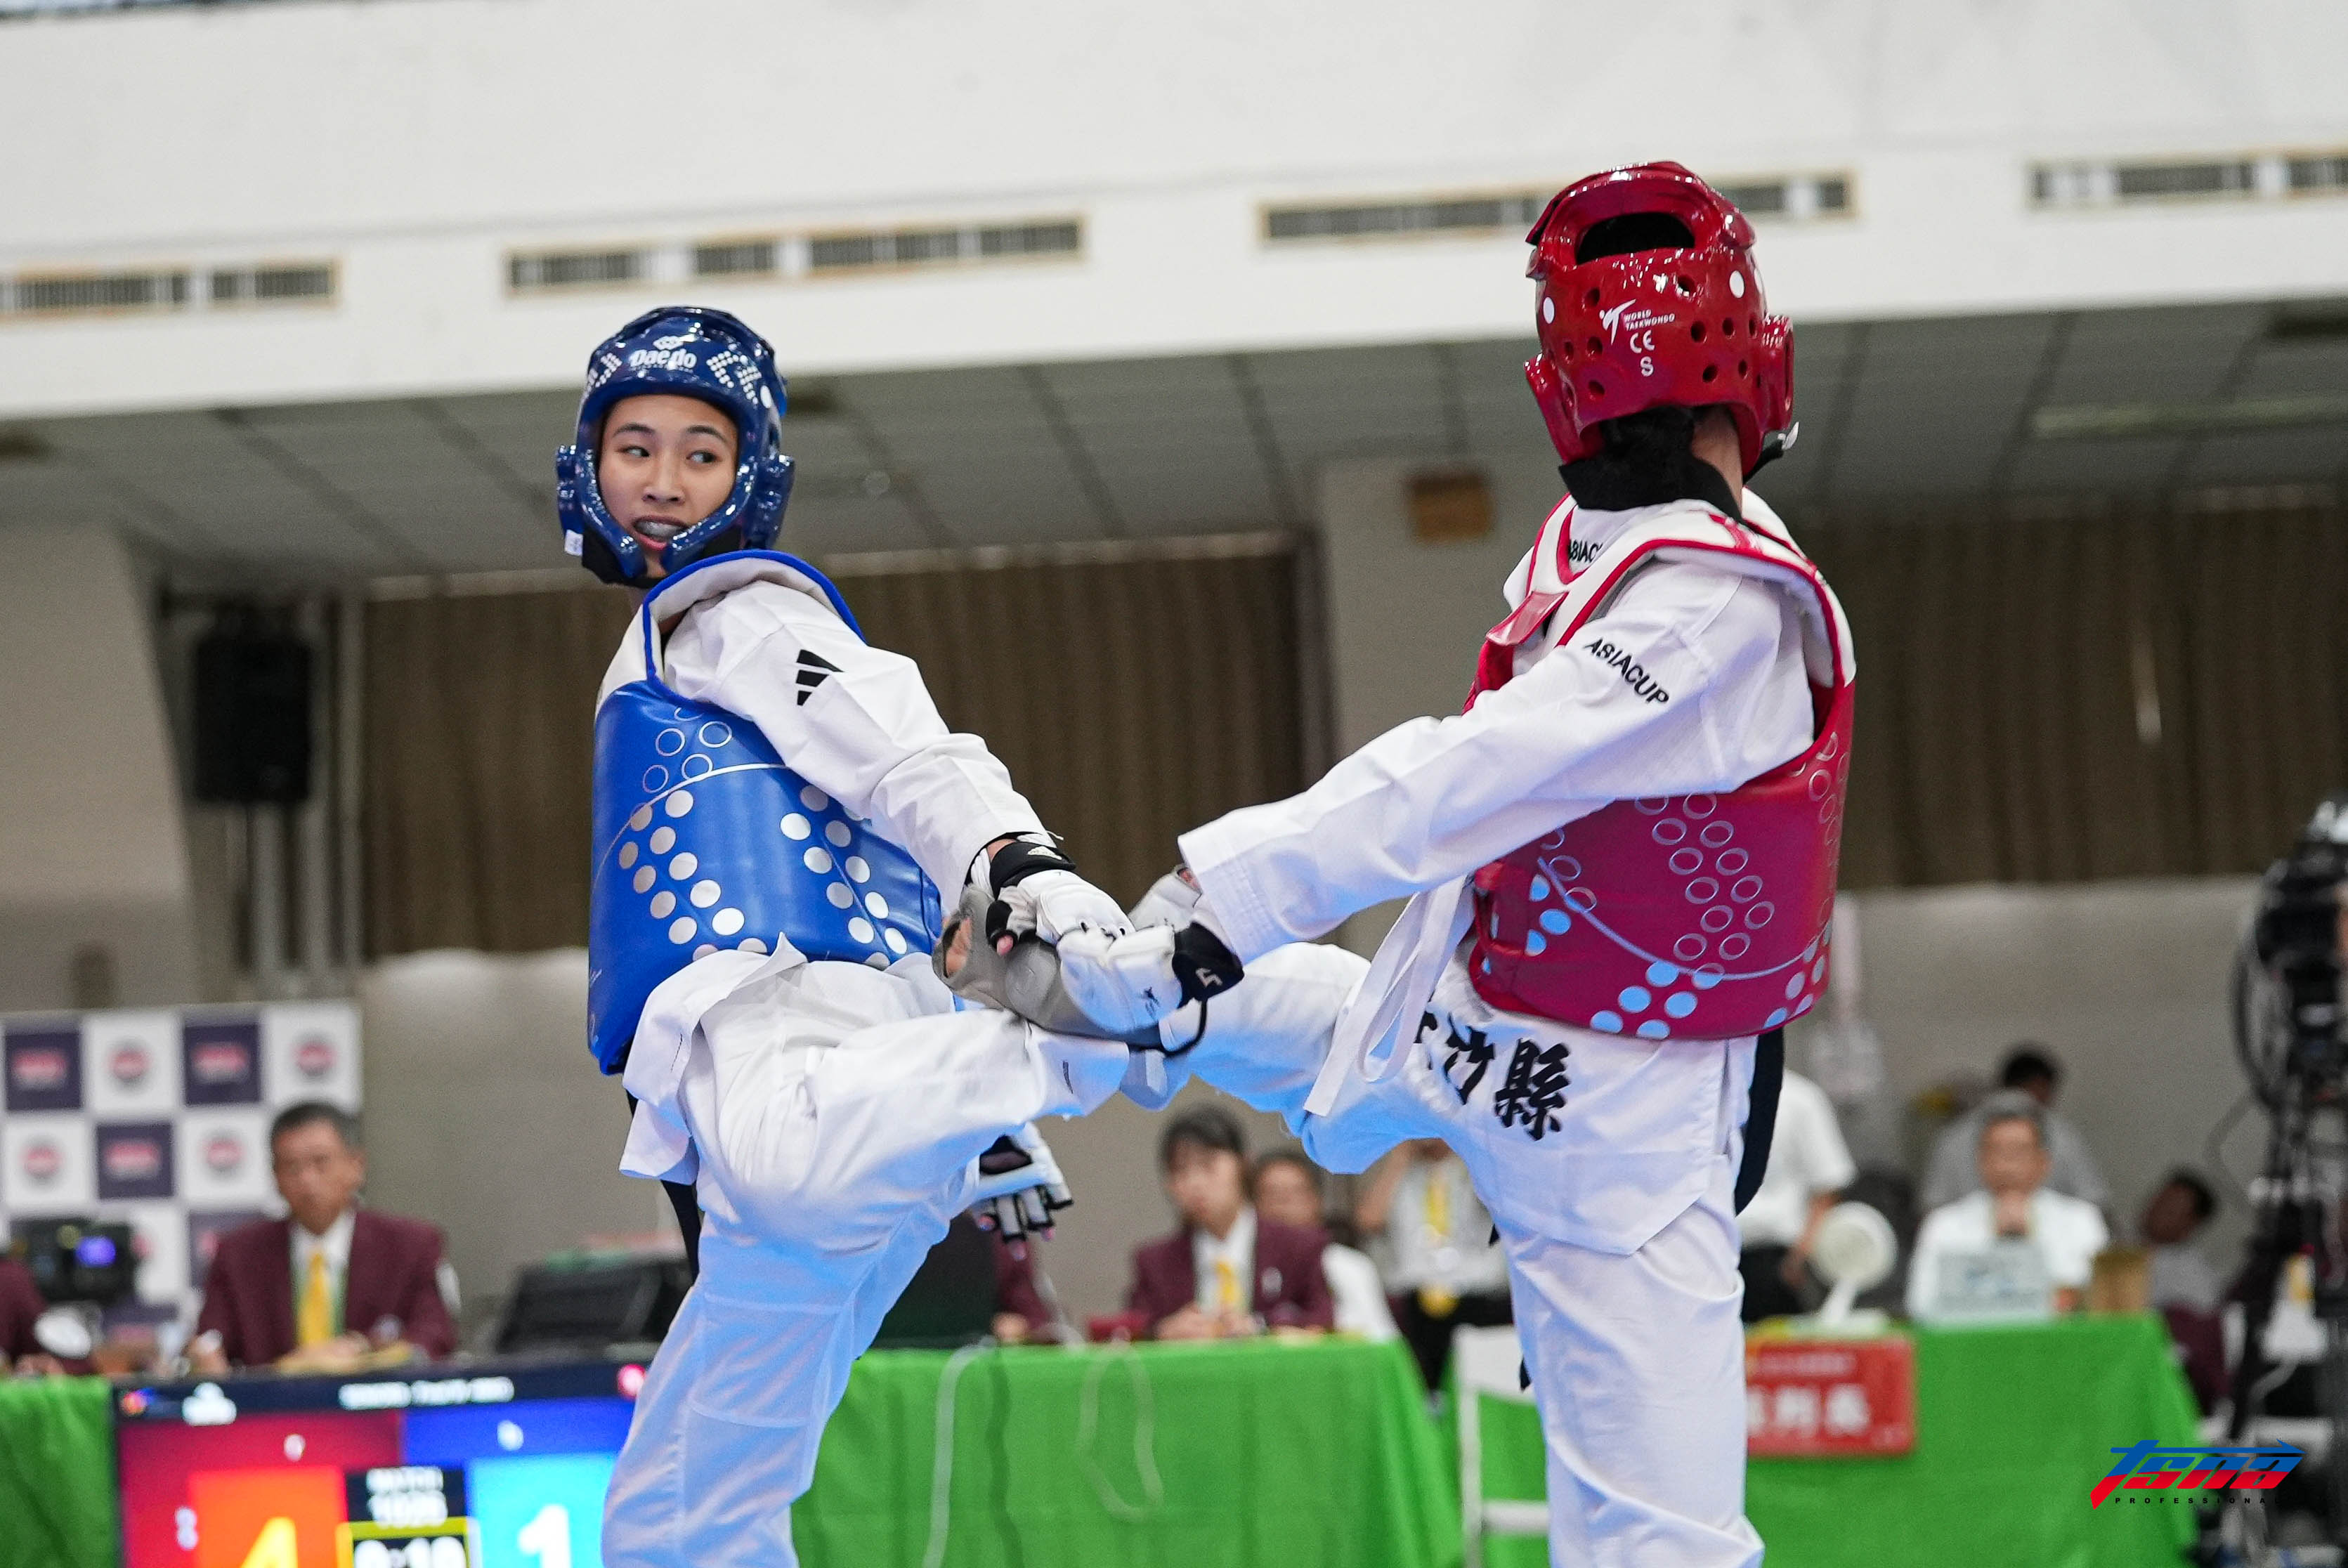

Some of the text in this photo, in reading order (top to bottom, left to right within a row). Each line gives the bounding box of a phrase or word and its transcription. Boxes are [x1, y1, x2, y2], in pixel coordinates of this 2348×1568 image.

[1624, 309, 1652, 323] WORLD
[1625, 313, 1675, 331] TAEKWONDO
[1630, 329, 1655, 353] CE
[1640, 356, 1654, 377] S
[1584, 637, 1669, 704] ASIACUP
